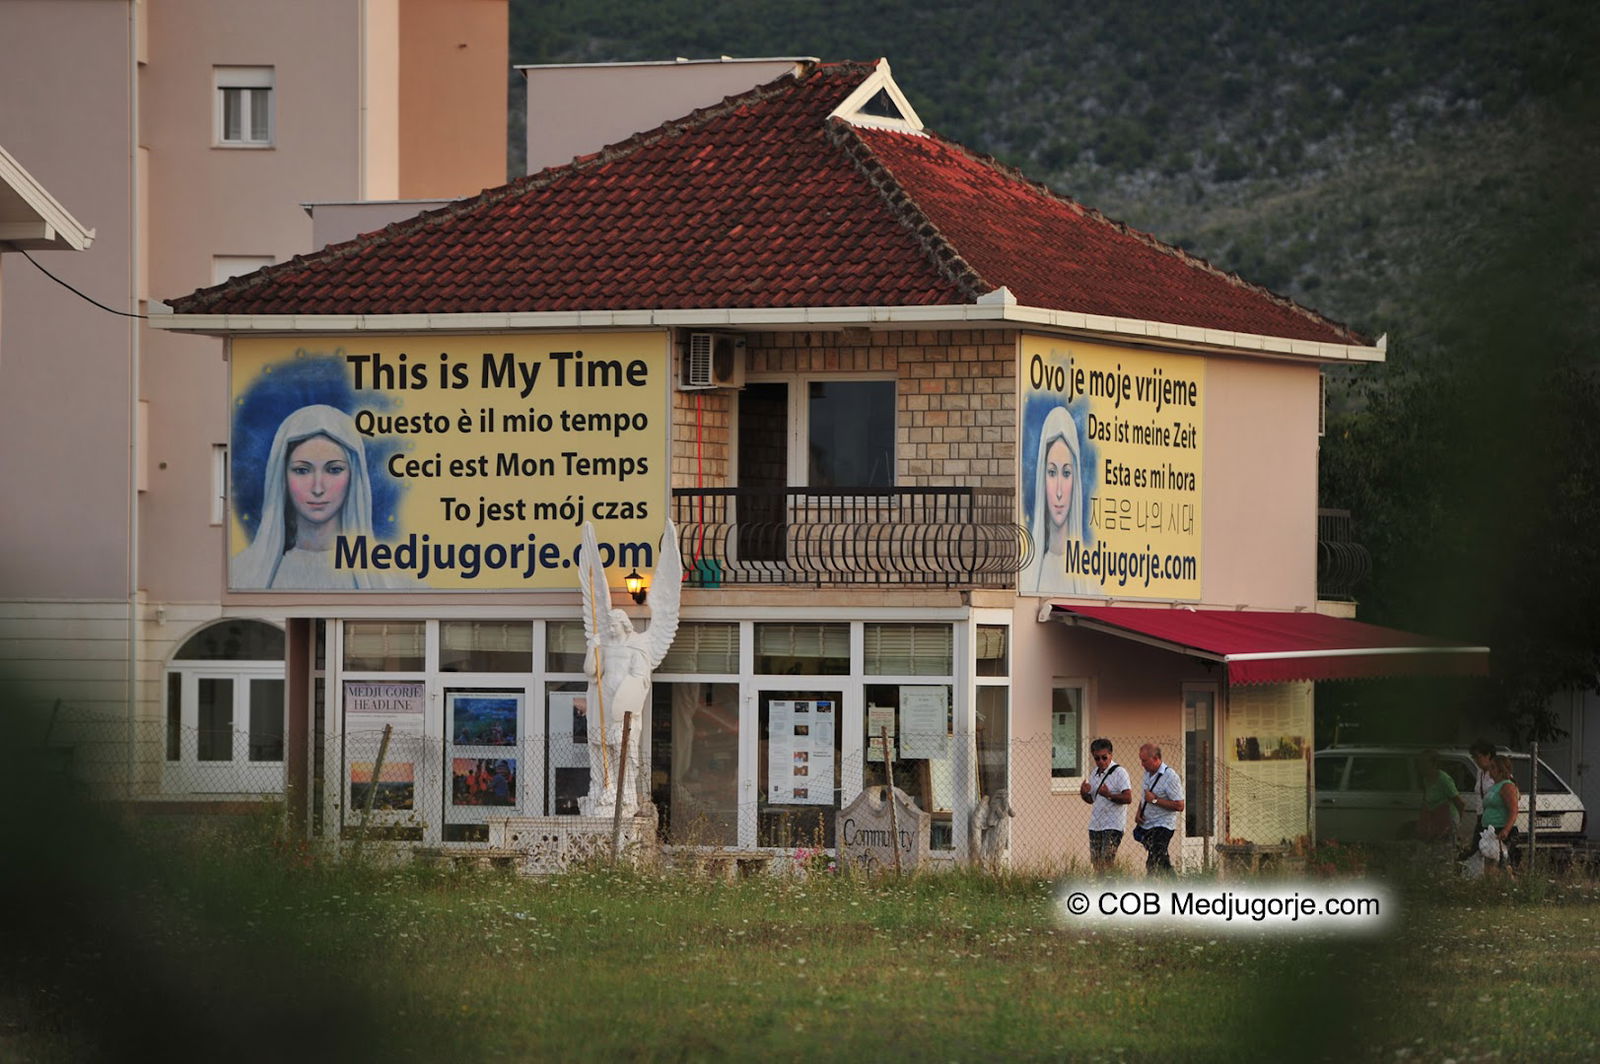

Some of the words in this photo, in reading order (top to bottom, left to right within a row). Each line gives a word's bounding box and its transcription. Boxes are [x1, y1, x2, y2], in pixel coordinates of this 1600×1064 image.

[347, 353, 428, 391] This
[440, 352, 469, 390] is
[481, 352, 541, 399] My
[549, 350, 648, 388] Time
[1030, 353, 1065, 392] Ovo
[1068, 358, 1085, 404] je
[1089, 363, 1131, 409] moje
[1135, 368, 1197, 413] vrijeme
[355, 410, 450, 438] Questo
[457, 408, 473, 434] è
[480, 407, 494, 433] il
[503, 407, 553, 433] mio
[559, 410, 648, 438] tempo
[1088, 413, 1111, 442] Das
[1114, 416, 1129, 444] ist
[1132, 420, 1170, 448] meine
[1173, 422, 1196, 449] Zeit
[388, 452, 441, 478] Ceci
[449, 456, 489, 478] est
[496, 452, 555, 477] Mon
[561, 451, 648, 482] Temps
[1105, 459, 1131, 487] Esta
[1134, 468, 1147, 489] es
[1150, 463, 1165, 490] mi
[1168, 463, 1195, 491] hora
[440, 497, 471, 522] To
[476, 496, 527, 528] jest
[534, 495, 584, 527] mój
[592, 501, 648, 520] czas
[1090, 497, 1132, 531] 지금은
[1137, 500, 1162, 534] 나의
[1168, 503, 1194, 537] 시대
[1065, 539, 1196, 588] Medjugorje.com
[349, 687, 421, 698] MEDJUGORJE
[354, 699, 413, 710] HEADLINE
[843, 818, 914, 852] Commuty
